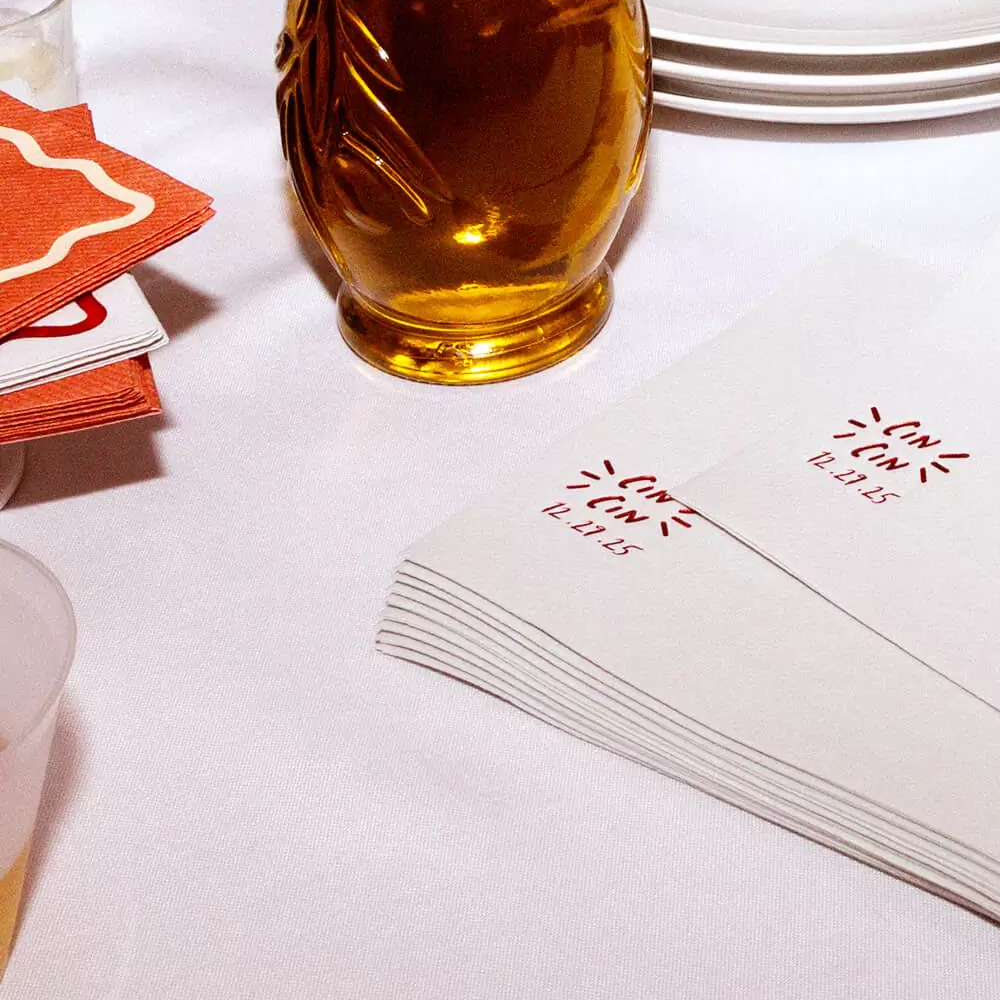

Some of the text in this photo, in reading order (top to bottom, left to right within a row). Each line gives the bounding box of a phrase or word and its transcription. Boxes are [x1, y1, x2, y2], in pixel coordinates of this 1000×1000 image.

[883, 421, 942, 449] CIN
[850, 443, 910, 471] CIN
[618, 475, 674, 504] CIN
[586, 496, 650, 524] CIN
